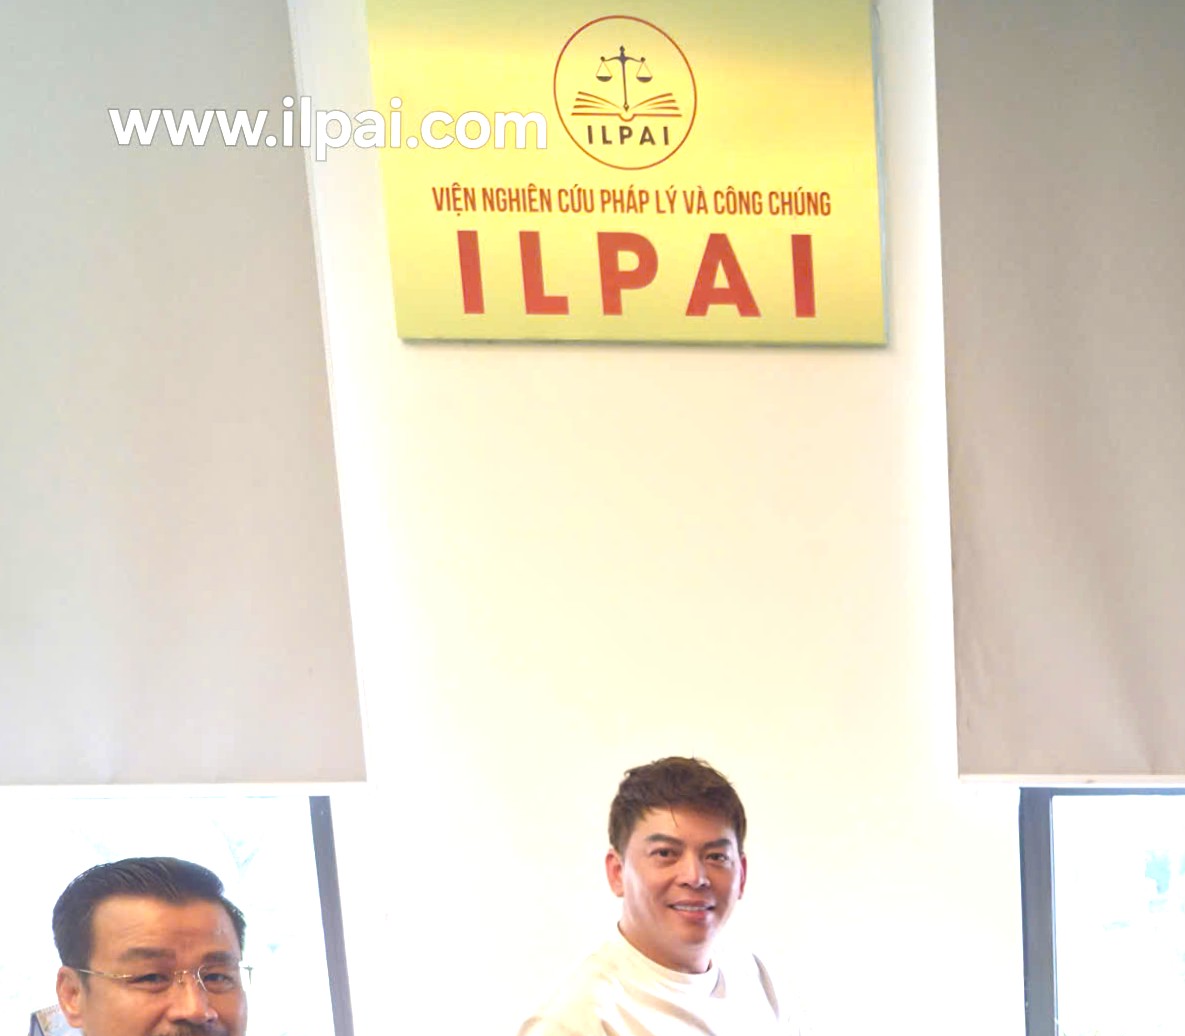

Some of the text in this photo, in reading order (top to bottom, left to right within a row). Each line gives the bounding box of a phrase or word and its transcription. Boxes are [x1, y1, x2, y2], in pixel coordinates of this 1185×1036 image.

[587, 124, 670, 146] ILPAI
[431, 181, 478, 217] VIỆN
[482, 182, 553, 213] NGHIÊN
[600, 184, 650, 214] PHÁP
[655, 184, 677, 214] LÝ
[682, 185, 709, 215] VÀ
[713, 185, 763, 216] CÔNG
[456, 229, 817, 319] ILPAI
